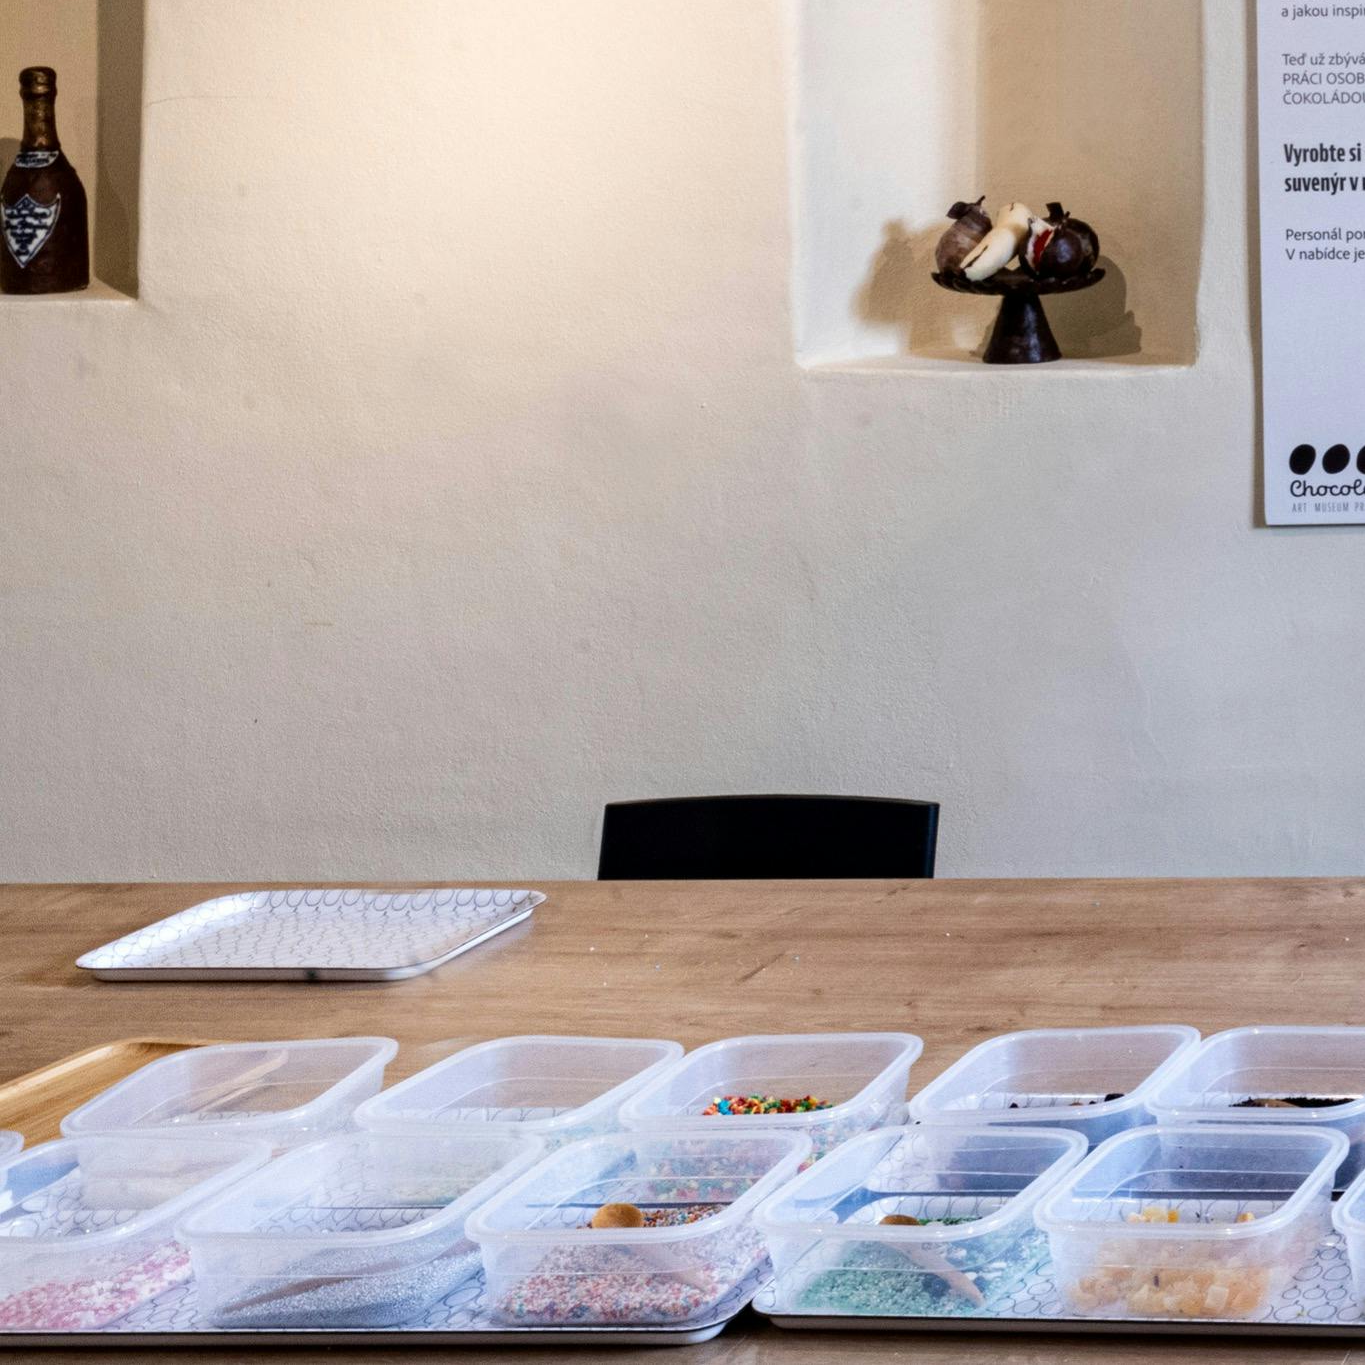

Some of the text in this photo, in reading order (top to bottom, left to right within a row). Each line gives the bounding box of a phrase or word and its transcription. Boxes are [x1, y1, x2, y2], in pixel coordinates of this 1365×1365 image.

[1281, 8, 1288, 17] a
[1292, 4, 1328, 20] jakou
[1282, 53, 1307, 65] Teď
[1310, 53, 1325, 65] už
[1328, 52, 1365, 68] zbývá
[1283, 70, 1322, 85] PRÁCI
[1284, 143, 1345, 167] Vyrobte
[1349, 143, 1361, 162] si
[1285, 172, 1346, 195] suvenýr
[1349, 177, 1358, 191] v
[1286, 227, 1342, 241] Personál
[1285, 249, 1295, 260] V
[1299, 247, 1350, 260] nabídce
[1353, 247, 1365, 263] je
[1292, 503, 1306, 512] ART
[1315, 502, 1348, 512] MUSEUM
